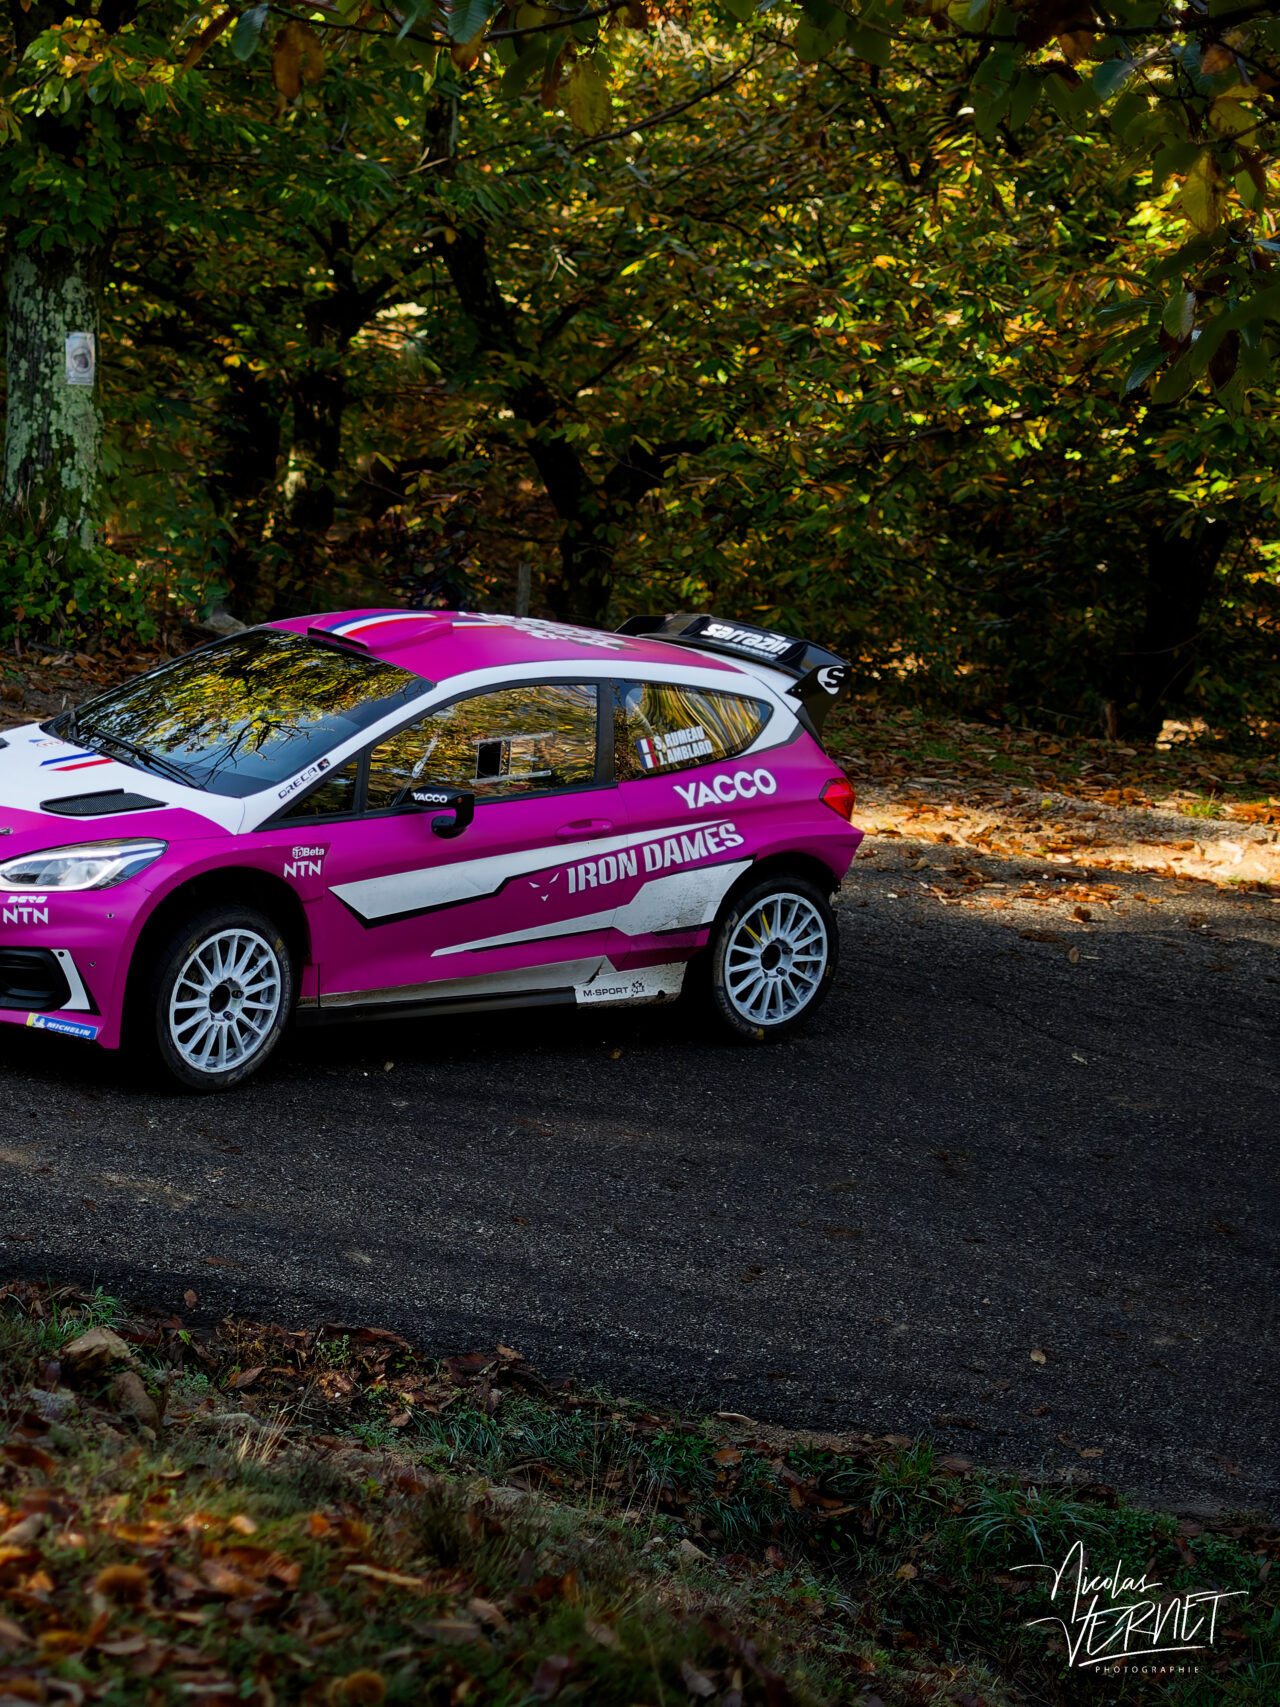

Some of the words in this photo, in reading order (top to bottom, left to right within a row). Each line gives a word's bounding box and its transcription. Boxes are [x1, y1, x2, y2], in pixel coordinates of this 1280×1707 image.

[700, 623, 793, 655] sarrazin
[664, 725, 705, 748] RUMEAU
[666, 739, 713, 764] AMBLARD
[278, 767, 317, 799] ORECA
[673, 768, 777, 809] YACCO
[412, 792, 448, 804] YACCO
[303, 846, 325, 857] Beta
[567, 849, 638, 894] IRON
[643, 822, 744, 873] DAMES
[283, 859, 322, 878] NTN
[2, 904, 49, 925] NTN
[46, 1021, 91, 1036] MICHELIN
